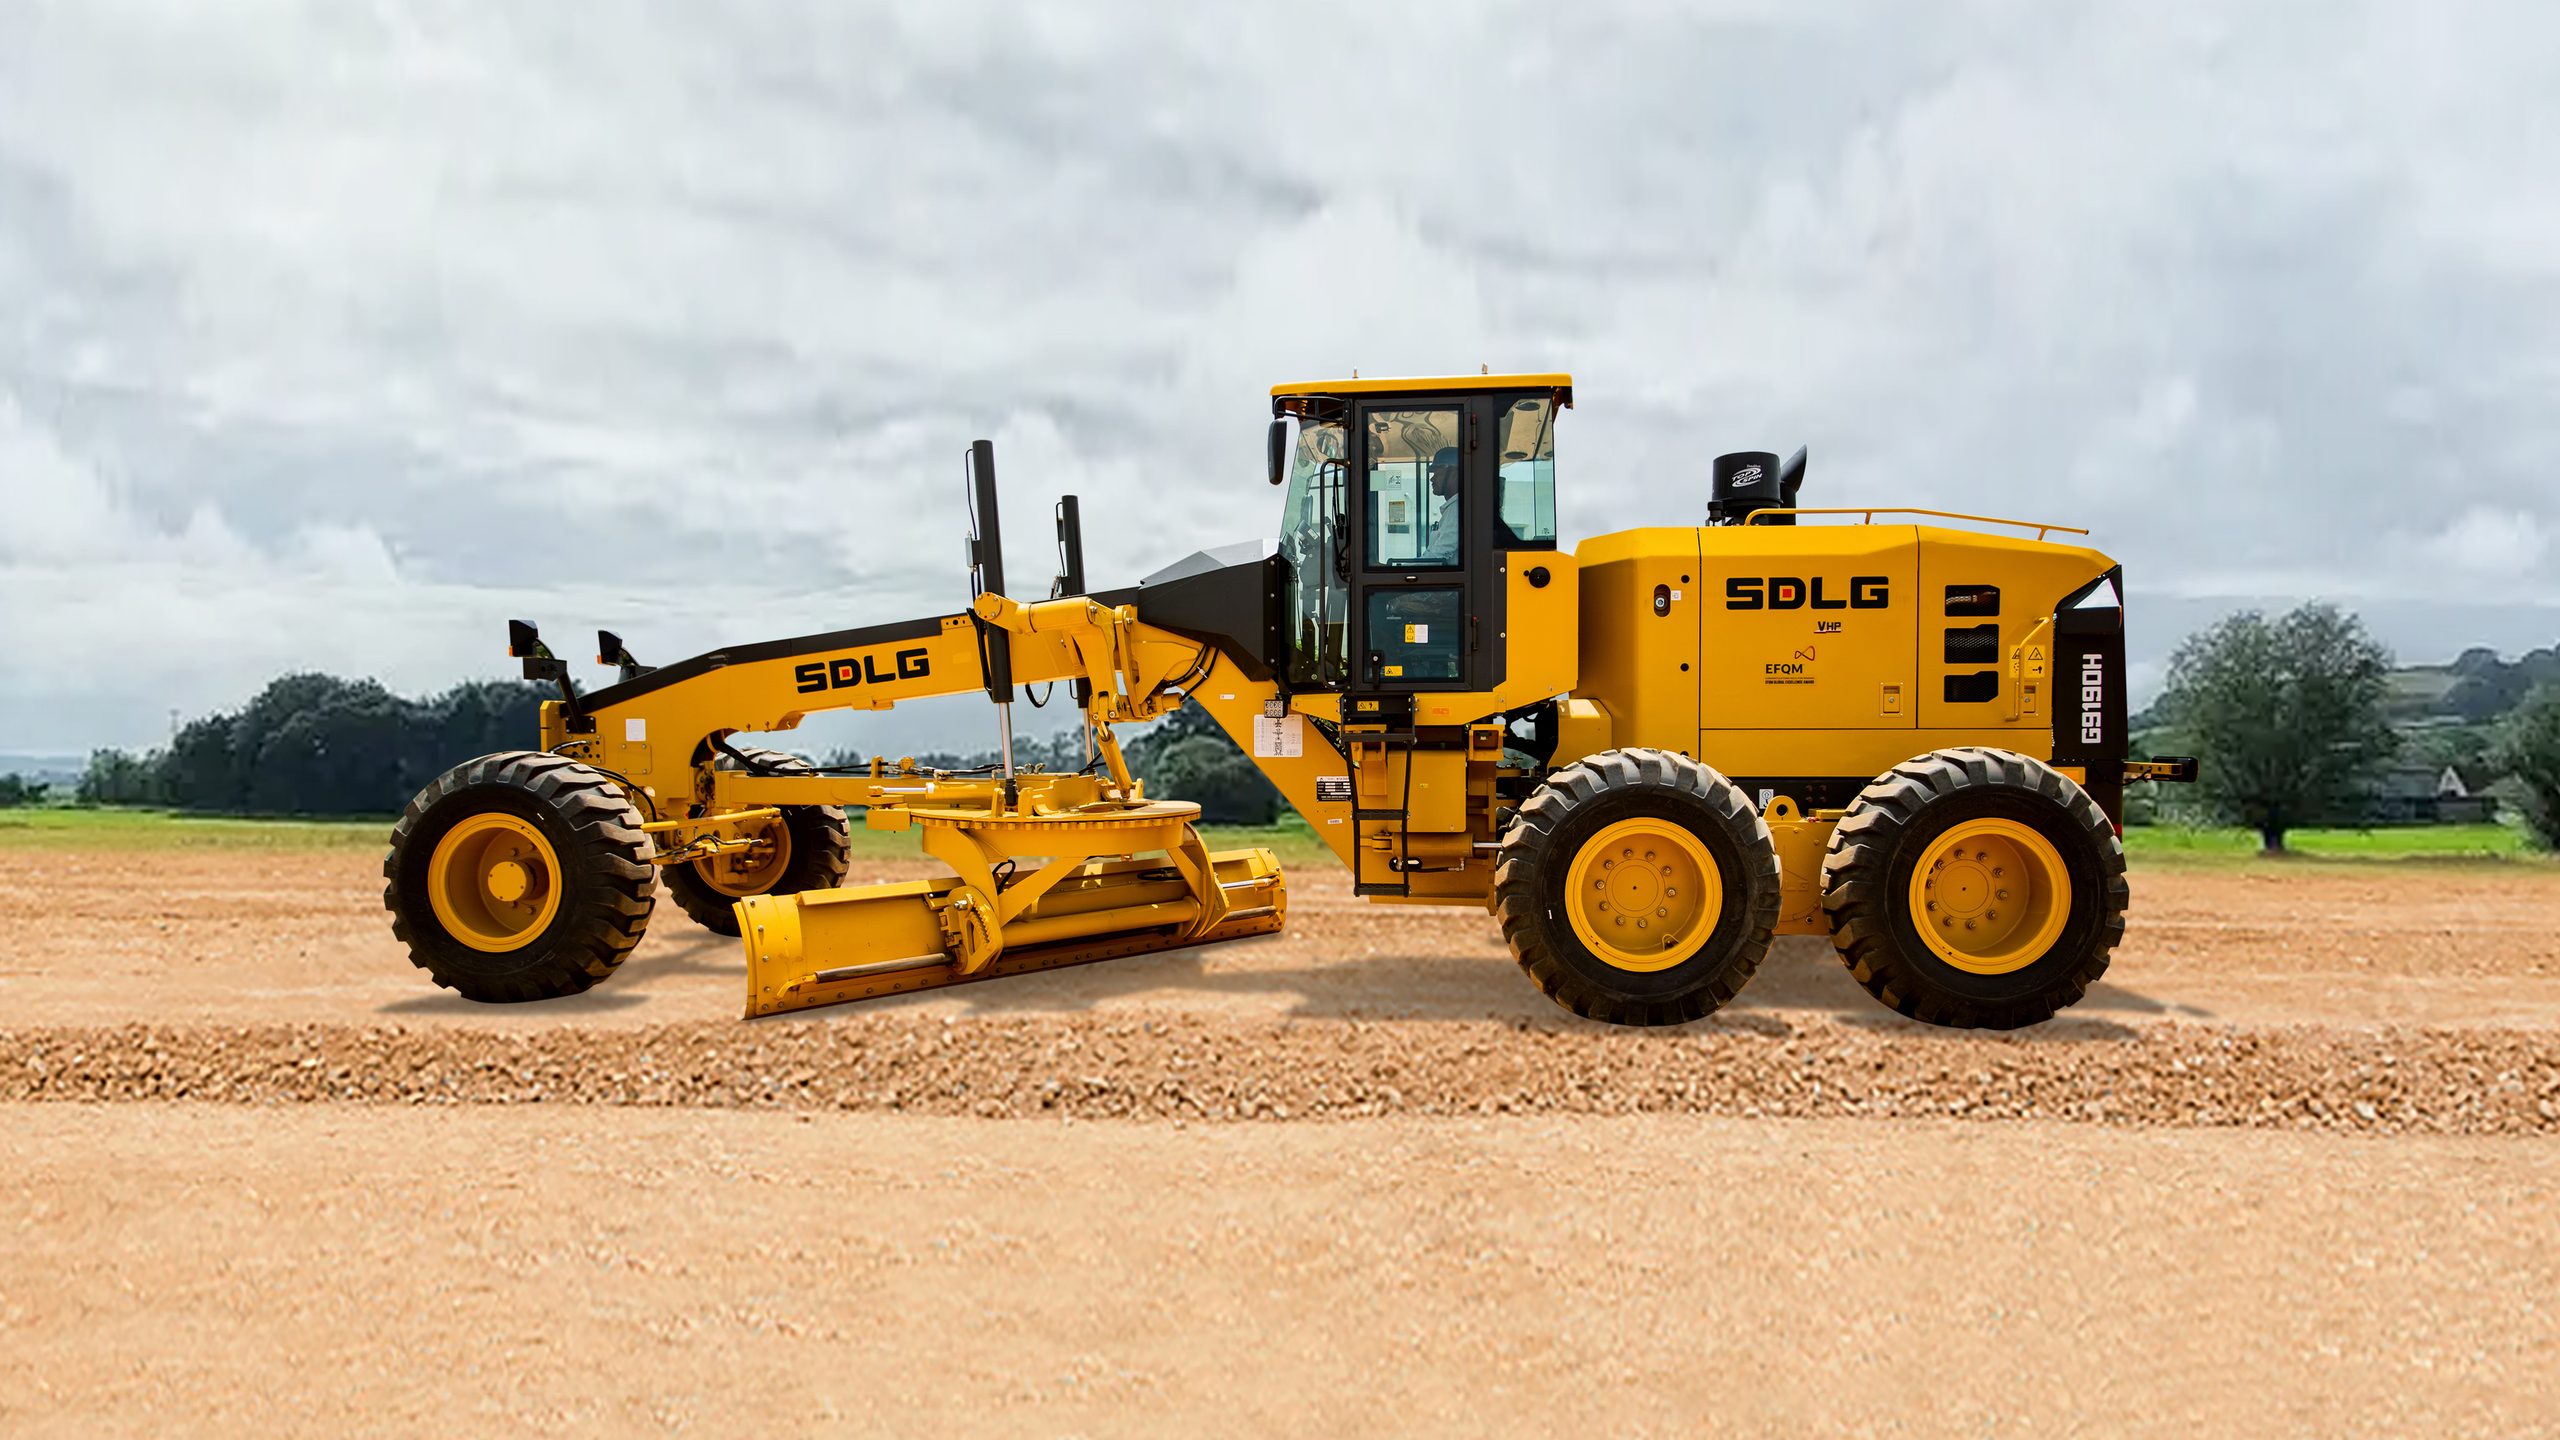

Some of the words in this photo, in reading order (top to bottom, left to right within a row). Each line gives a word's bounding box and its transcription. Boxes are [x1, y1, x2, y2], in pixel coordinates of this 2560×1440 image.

[1726, 576, 1889, 610] SDLG
[1817, 621, 1842, 631] VHP
[795, 648, 930, 693] SDLG
[1765, 663, 1803, 675] EFQM
[2081, 653, 2102, 744] G9190H
